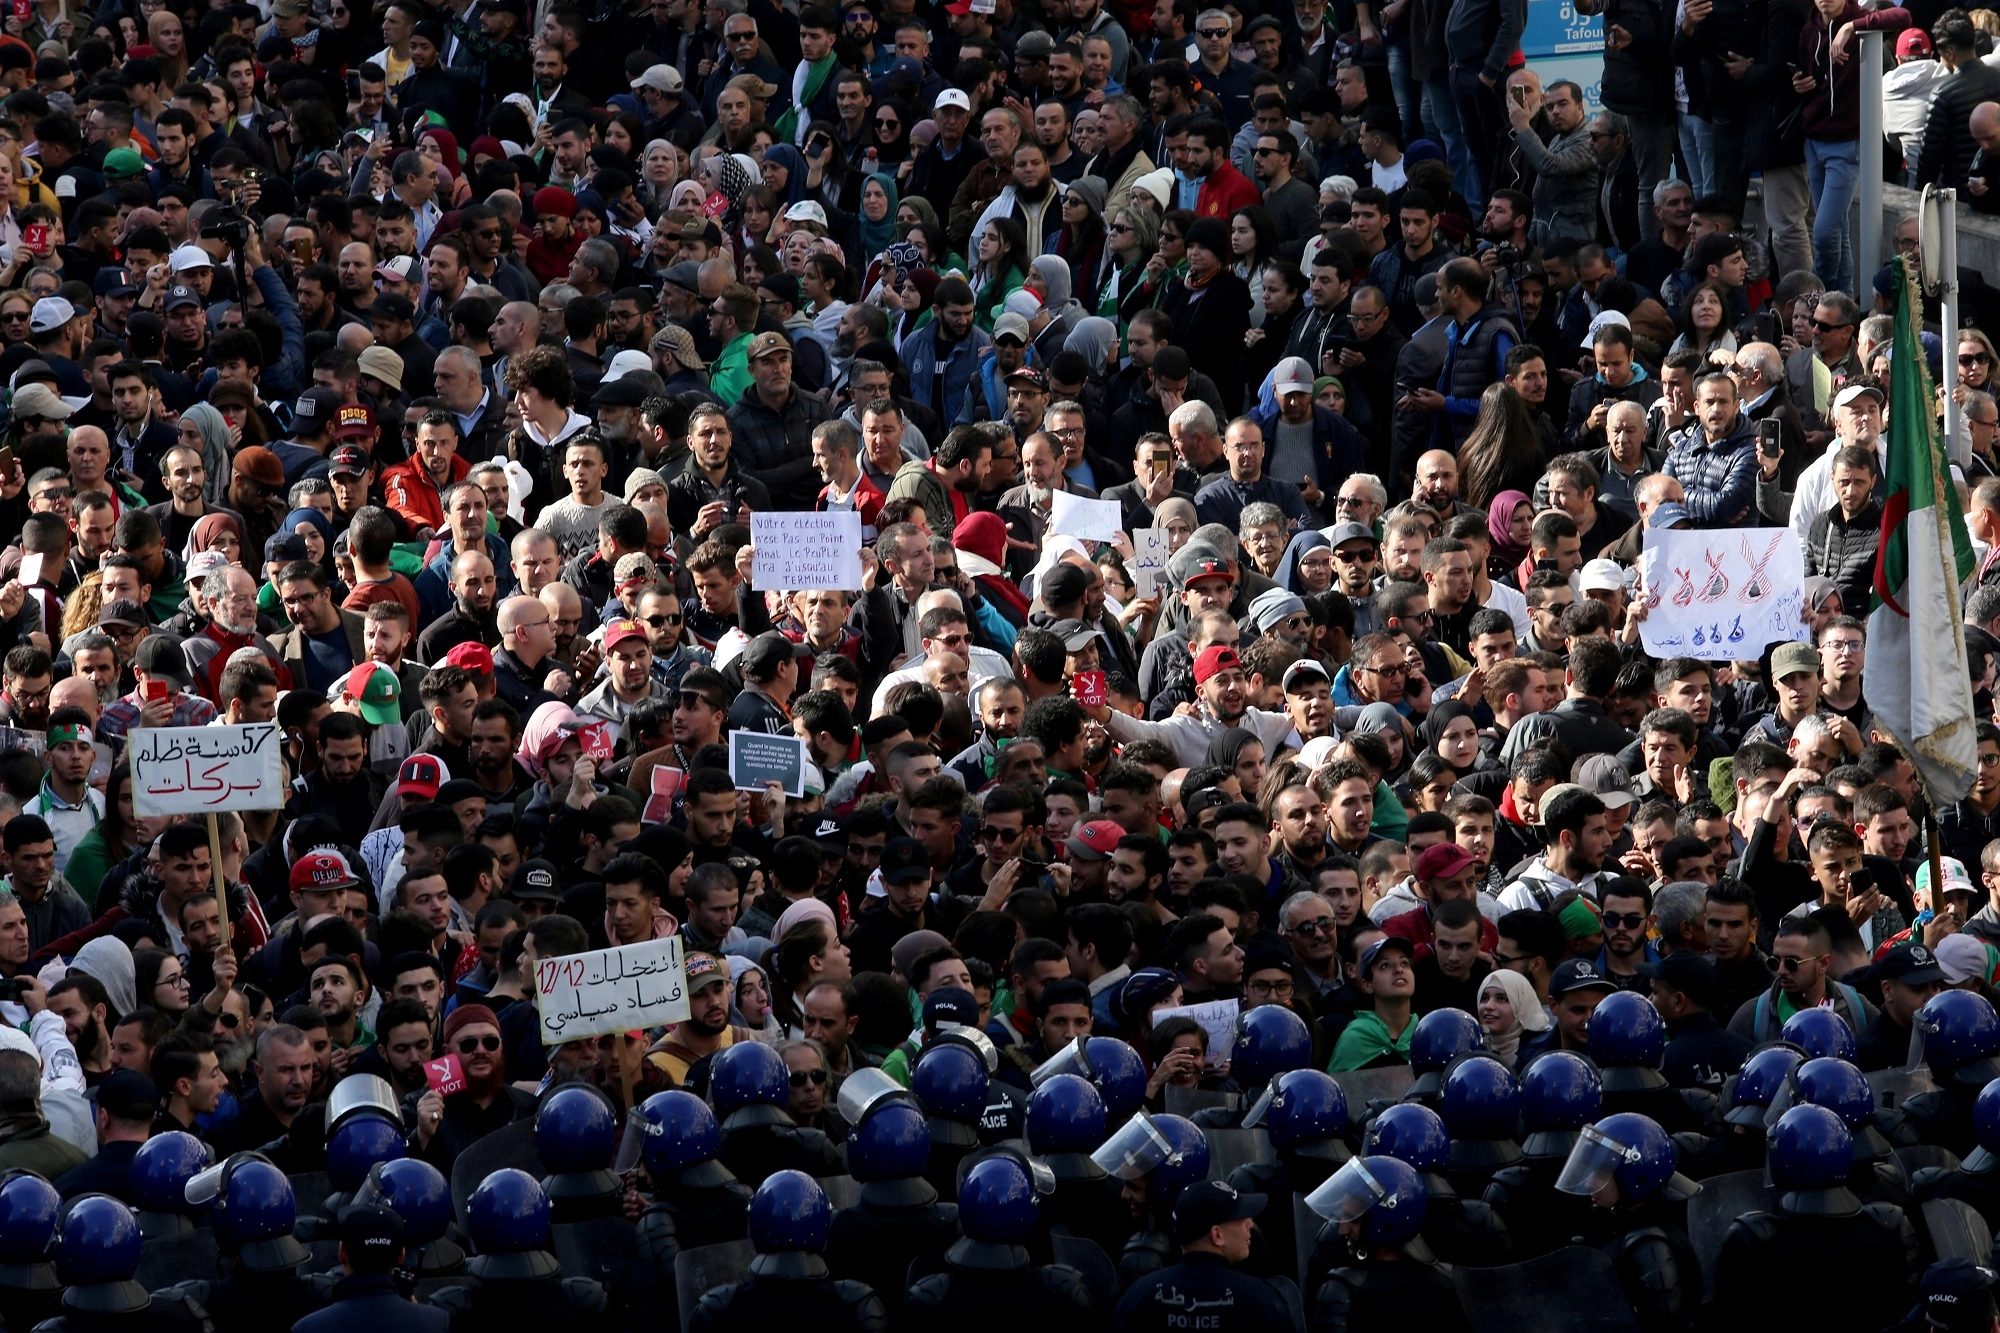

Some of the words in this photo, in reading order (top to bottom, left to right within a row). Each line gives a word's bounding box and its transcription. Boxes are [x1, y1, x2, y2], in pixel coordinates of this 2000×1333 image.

[756, 518, 786, 529] Votre
[755, 534, 779, 544] n'est
[806, 535, 816, 544] un
[757, 562, 776, 573] ira
[1696, 548, 1729, 604] لا
[1734, 530, 1785, 604] لا
[185, 737, 240, 759] سنة
[241, 725, 276, 755] 57
[136, 732, 183, 781] ظلم
[147, 758, 262, 804] بركات
[820, 819, 837, 831] NIKE
[587, 939, 679, 986] إنتخابات
[536, 959, 585, 995] 12/12
[627, 979, 682, 1008] فساد
[544, 989, 618, 1036] سياسي
[935, 1002, 958, 1011] POLICE
[1692, 1063, 1726, 1085] طة
[983, 1092, 1013, 1116] شر
[979, 1114, 1008, 1129] OLICE
[364, 1237, 393, 1246] POLICE
[1154, 1282, 1234, 1313] شرطة
[1928, 1293, 1959, 1306] POLICE
[1167, 1313, 1221, 1330] POLICE
